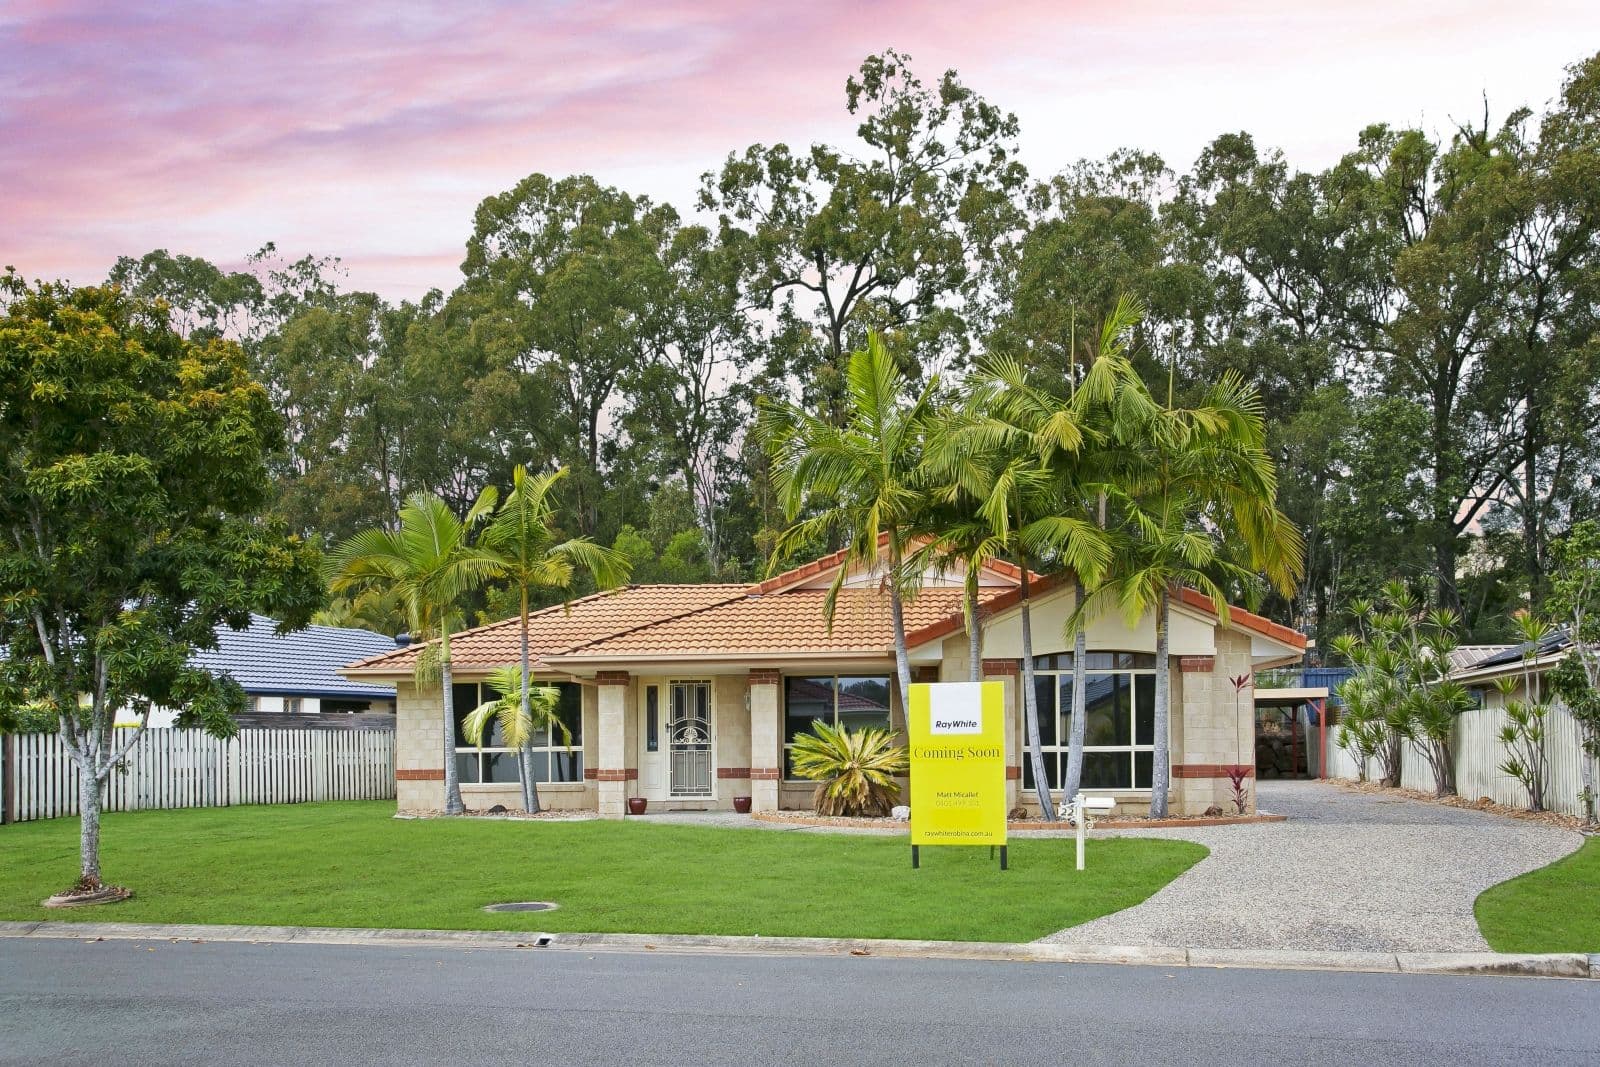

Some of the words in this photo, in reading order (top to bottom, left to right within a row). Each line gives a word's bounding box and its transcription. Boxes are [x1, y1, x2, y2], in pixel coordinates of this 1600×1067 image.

[914, 745, 964, 760] Coming
[968, 746, 1000, 758] Soon
[1060, 808, 1074, 816] 22
[924, 830, 993, 838] raywhiterobina.com.au
